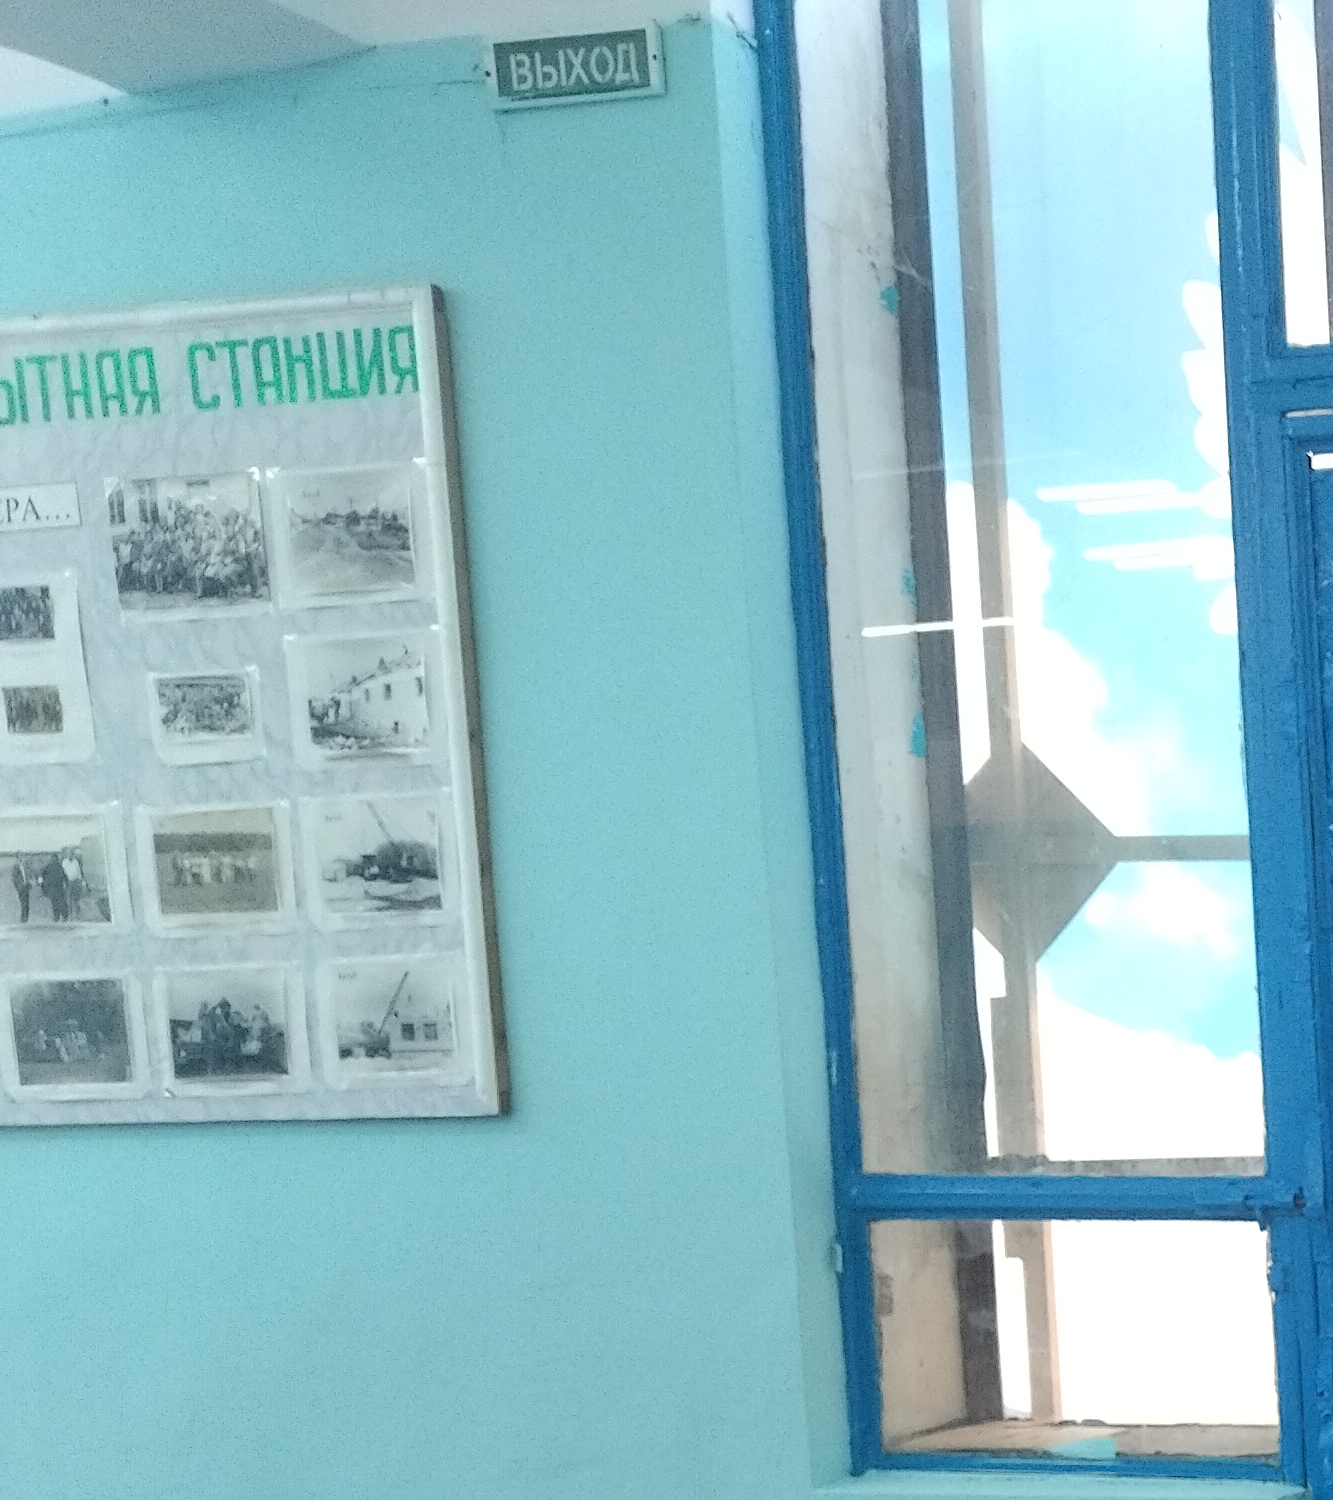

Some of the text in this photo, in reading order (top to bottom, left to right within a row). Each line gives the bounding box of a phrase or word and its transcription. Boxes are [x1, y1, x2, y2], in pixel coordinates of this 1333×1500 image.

[509, 42, 640, 91] ВЫХОД
[187, 325, 419, 410] СТАНЦИЯ
[0, 496, 70, 523] РА...
